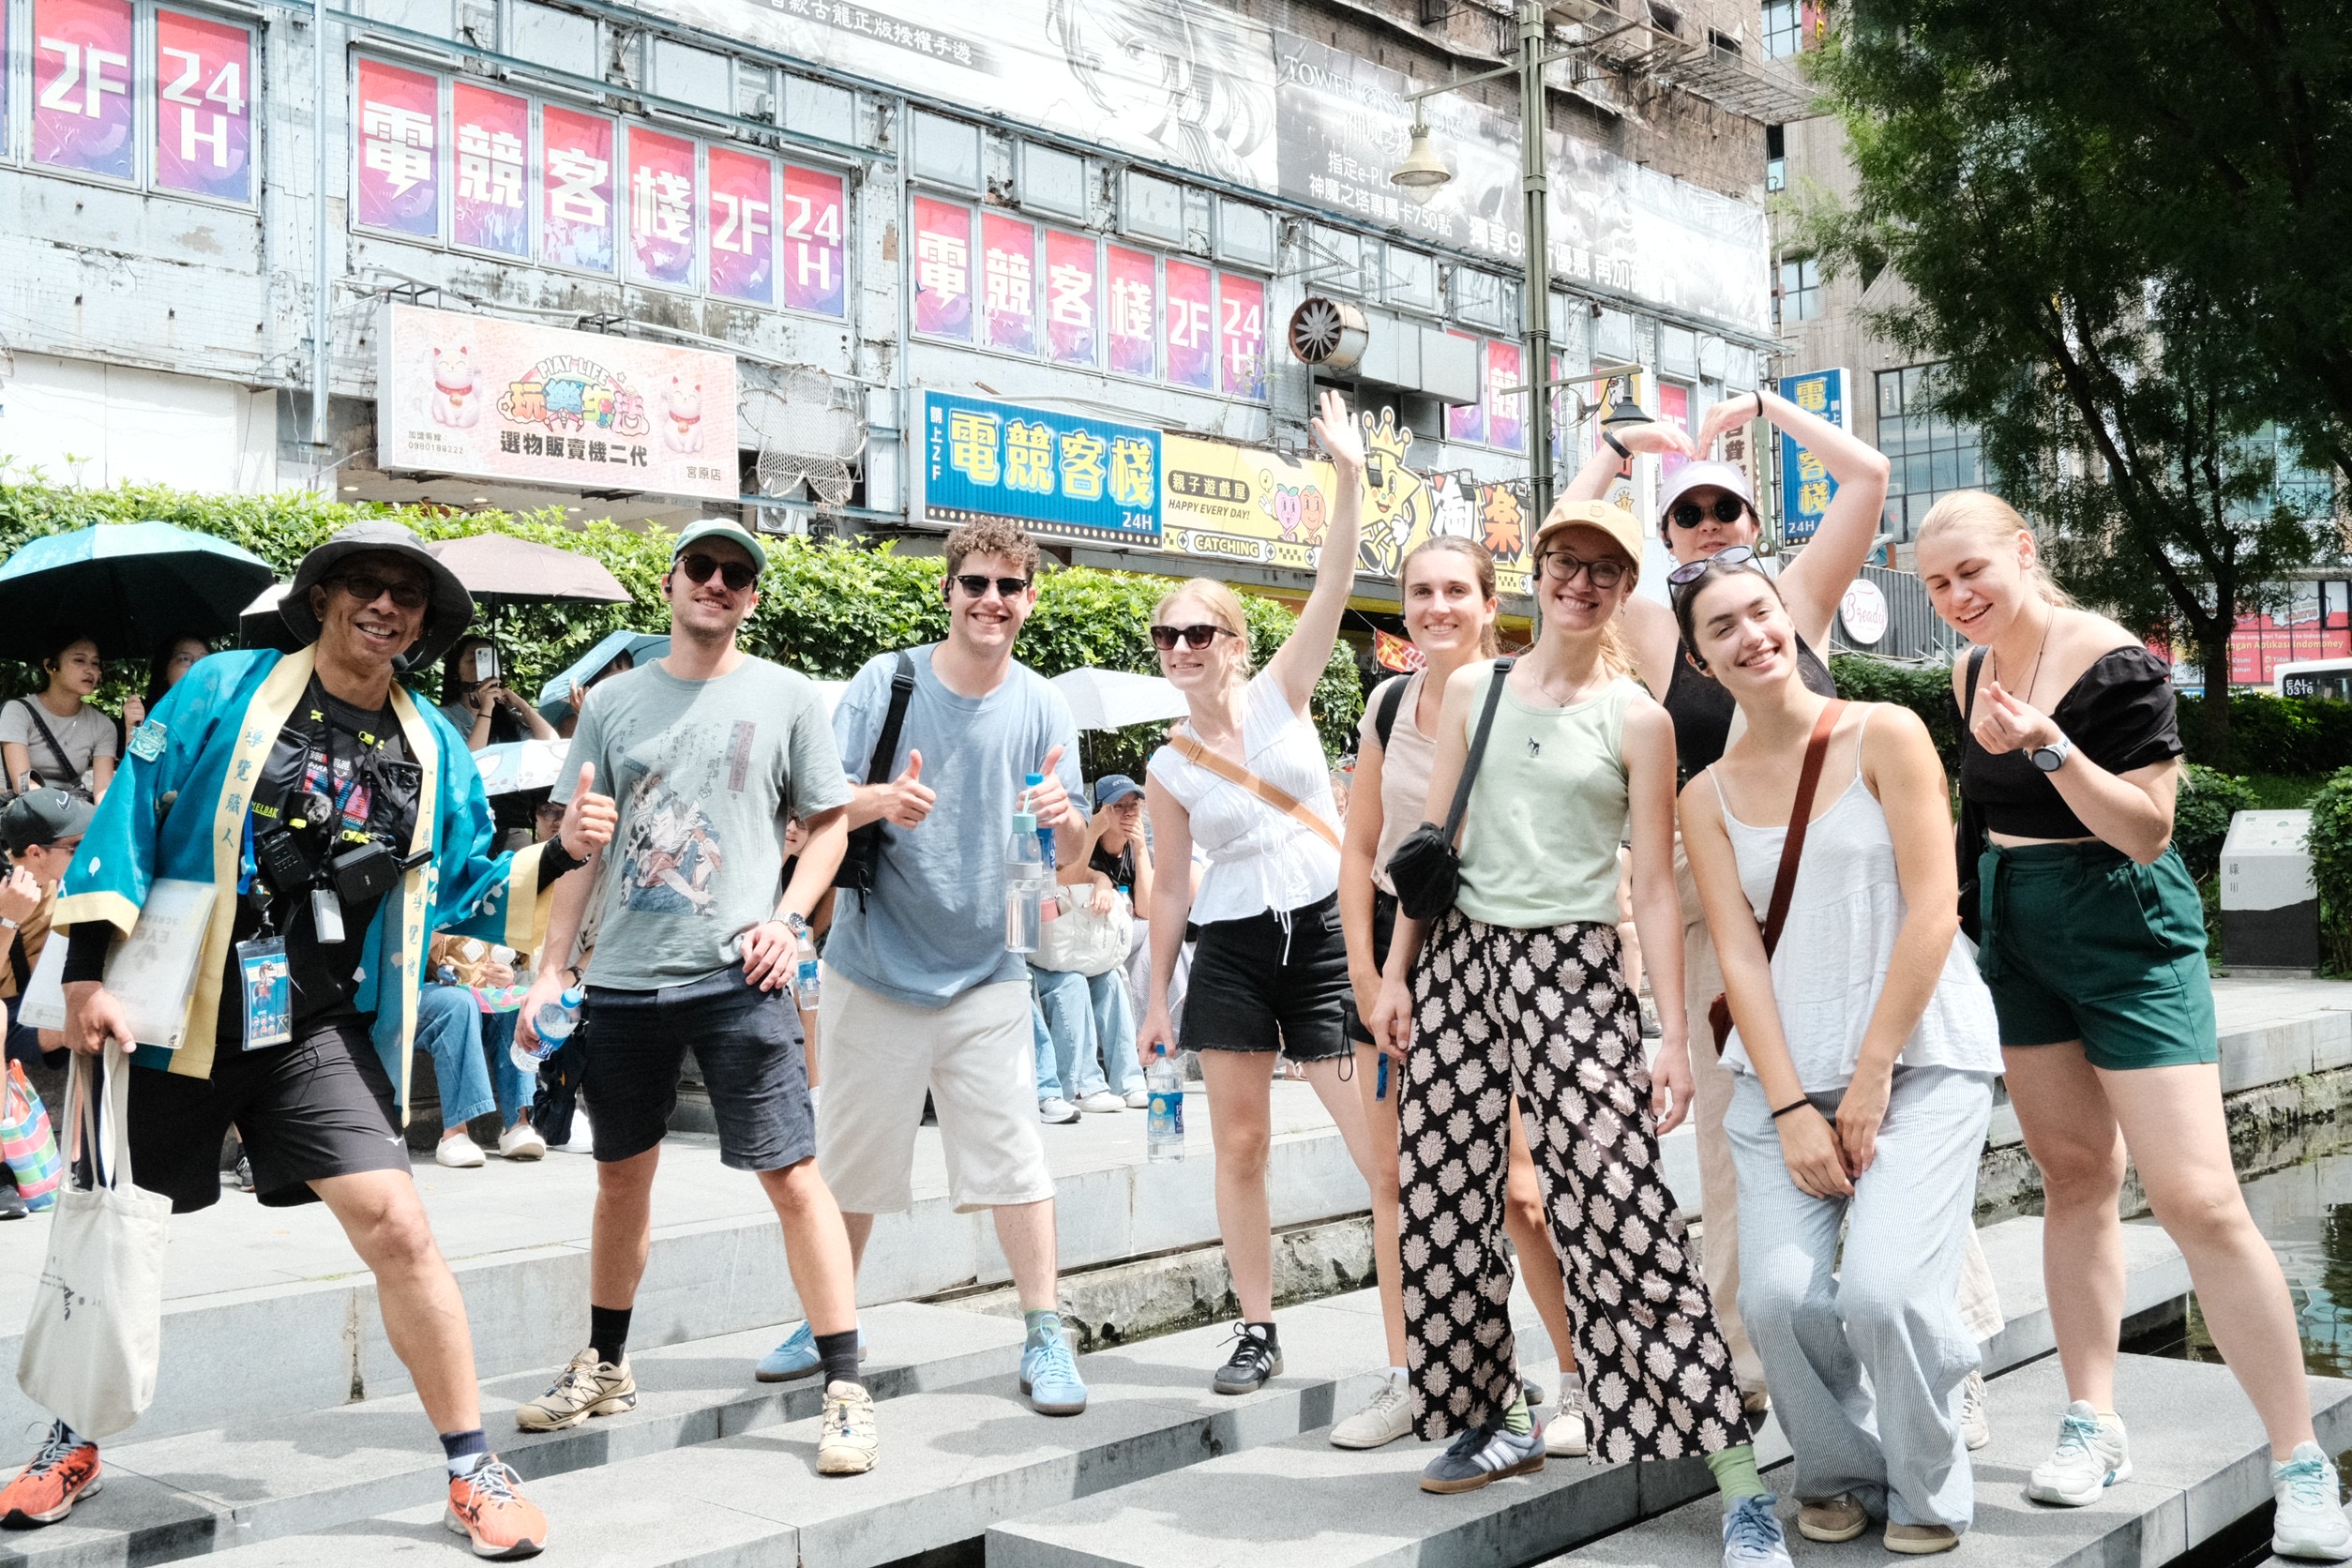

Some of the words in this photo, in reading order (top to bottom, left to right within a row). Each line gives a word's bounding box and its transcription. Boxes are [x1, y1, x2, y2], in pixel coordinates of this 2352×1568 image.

[39, 37, 127, 118] 2F
[162, 47, 245, 114] 24
[1284, 54, 1355, 99] TOWER
[181, 108, 230, 169] H
[363, 100, 692, 246] 電競客棧
[710, 190, 770, 256] 2F
[1328, 150, 1403, 193] 指定e-PLA
[798, 243, 831, 291] H
[918, 230, 1153, 341] 電競客棧
[1169, 297, 1210, 350] 2F
[1222, 297, 1262, 341] 24
[577, 357, 611, 385] LIFE
[501, 430, 647, 467] 選物販賣機二代
[949, 409, 1154, 508] 電競客棧
[1795, 378, 1829, 514] 電客棧
[686, 466, 721, 481] 宮原店
[1123, 512, 1153, 531] 24H
[1168, 499, 1199, 514] HAPPY
[1199, 504, 1229, 517] EVERY
[1230, 507, 1250, 520] DAY!
[1787, 520, 1815, 534] 24H
[1194, 535, 1260, 557] CATCHING
[2293, 639, 2344, 650] Indomoney
[2286, 678, 2314, 687] EAL-
[2286, 686, 2314, 695] 0316
[2229, 863, 2239, 893] 綠川
